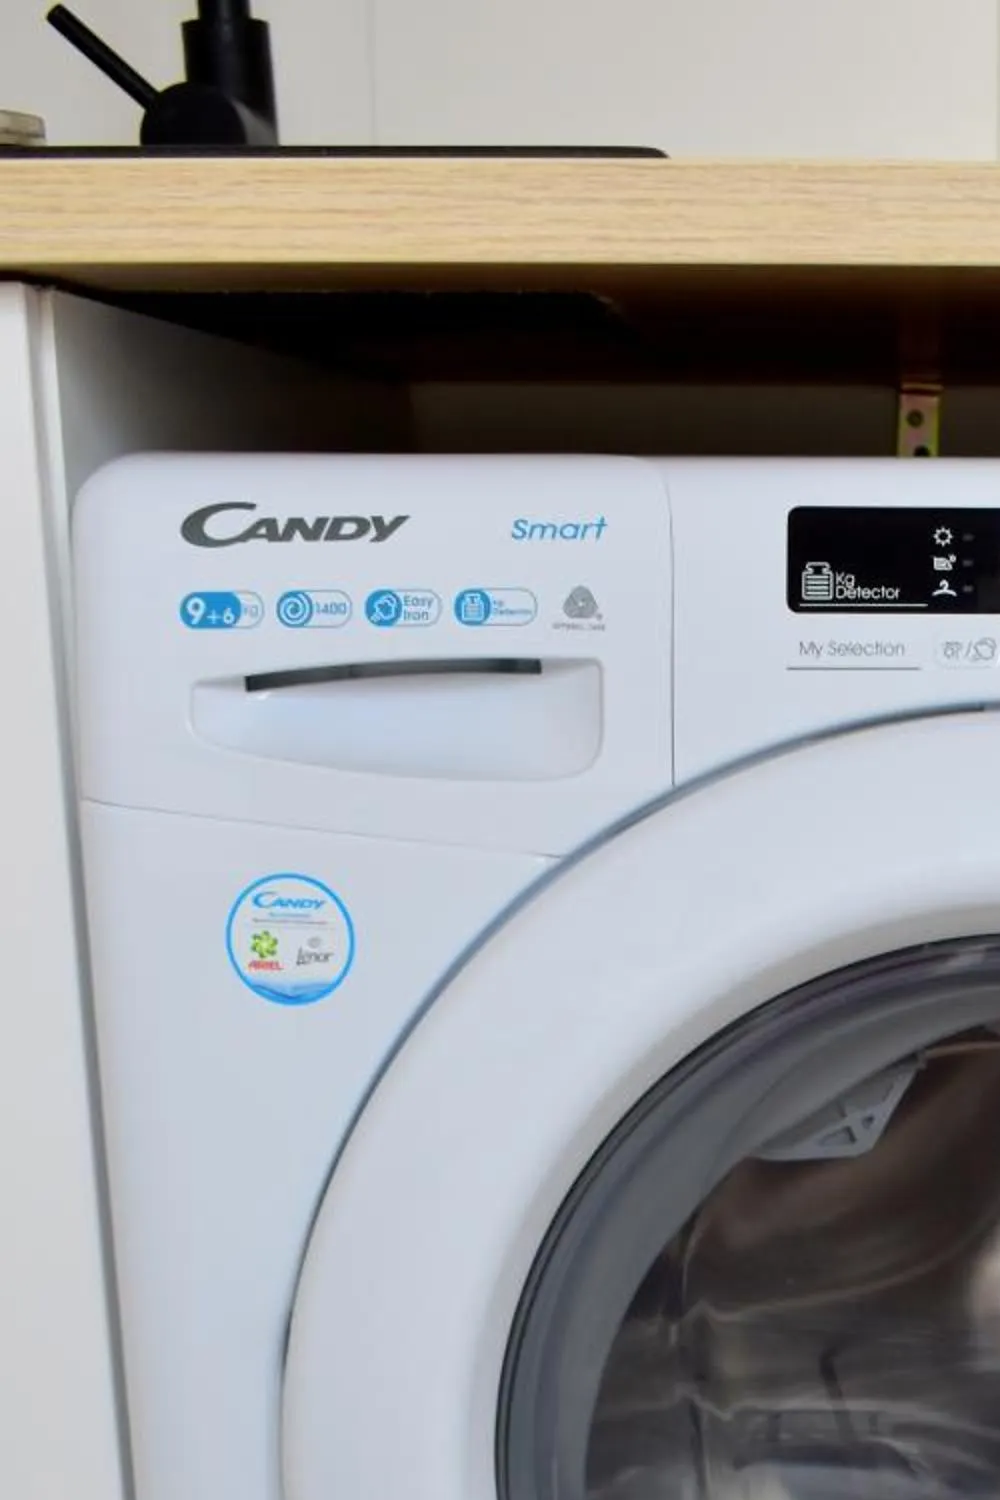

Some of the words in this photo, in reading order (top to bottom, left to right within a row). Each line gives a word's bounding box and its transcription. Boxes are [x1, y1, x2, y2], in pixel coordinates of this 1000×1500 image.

[181, 501, 411, 548] CANDY
[511, 515, 608, 541] Smart
[836, 571, 855, 588] Kg
[836, 585, 901, 600] Detector
[403, 595, 433, 610] Easy
[403, 608, 430, 622] Iron
[799, 641, 823, 660] My
[828, 640, 905, 657] Selection
